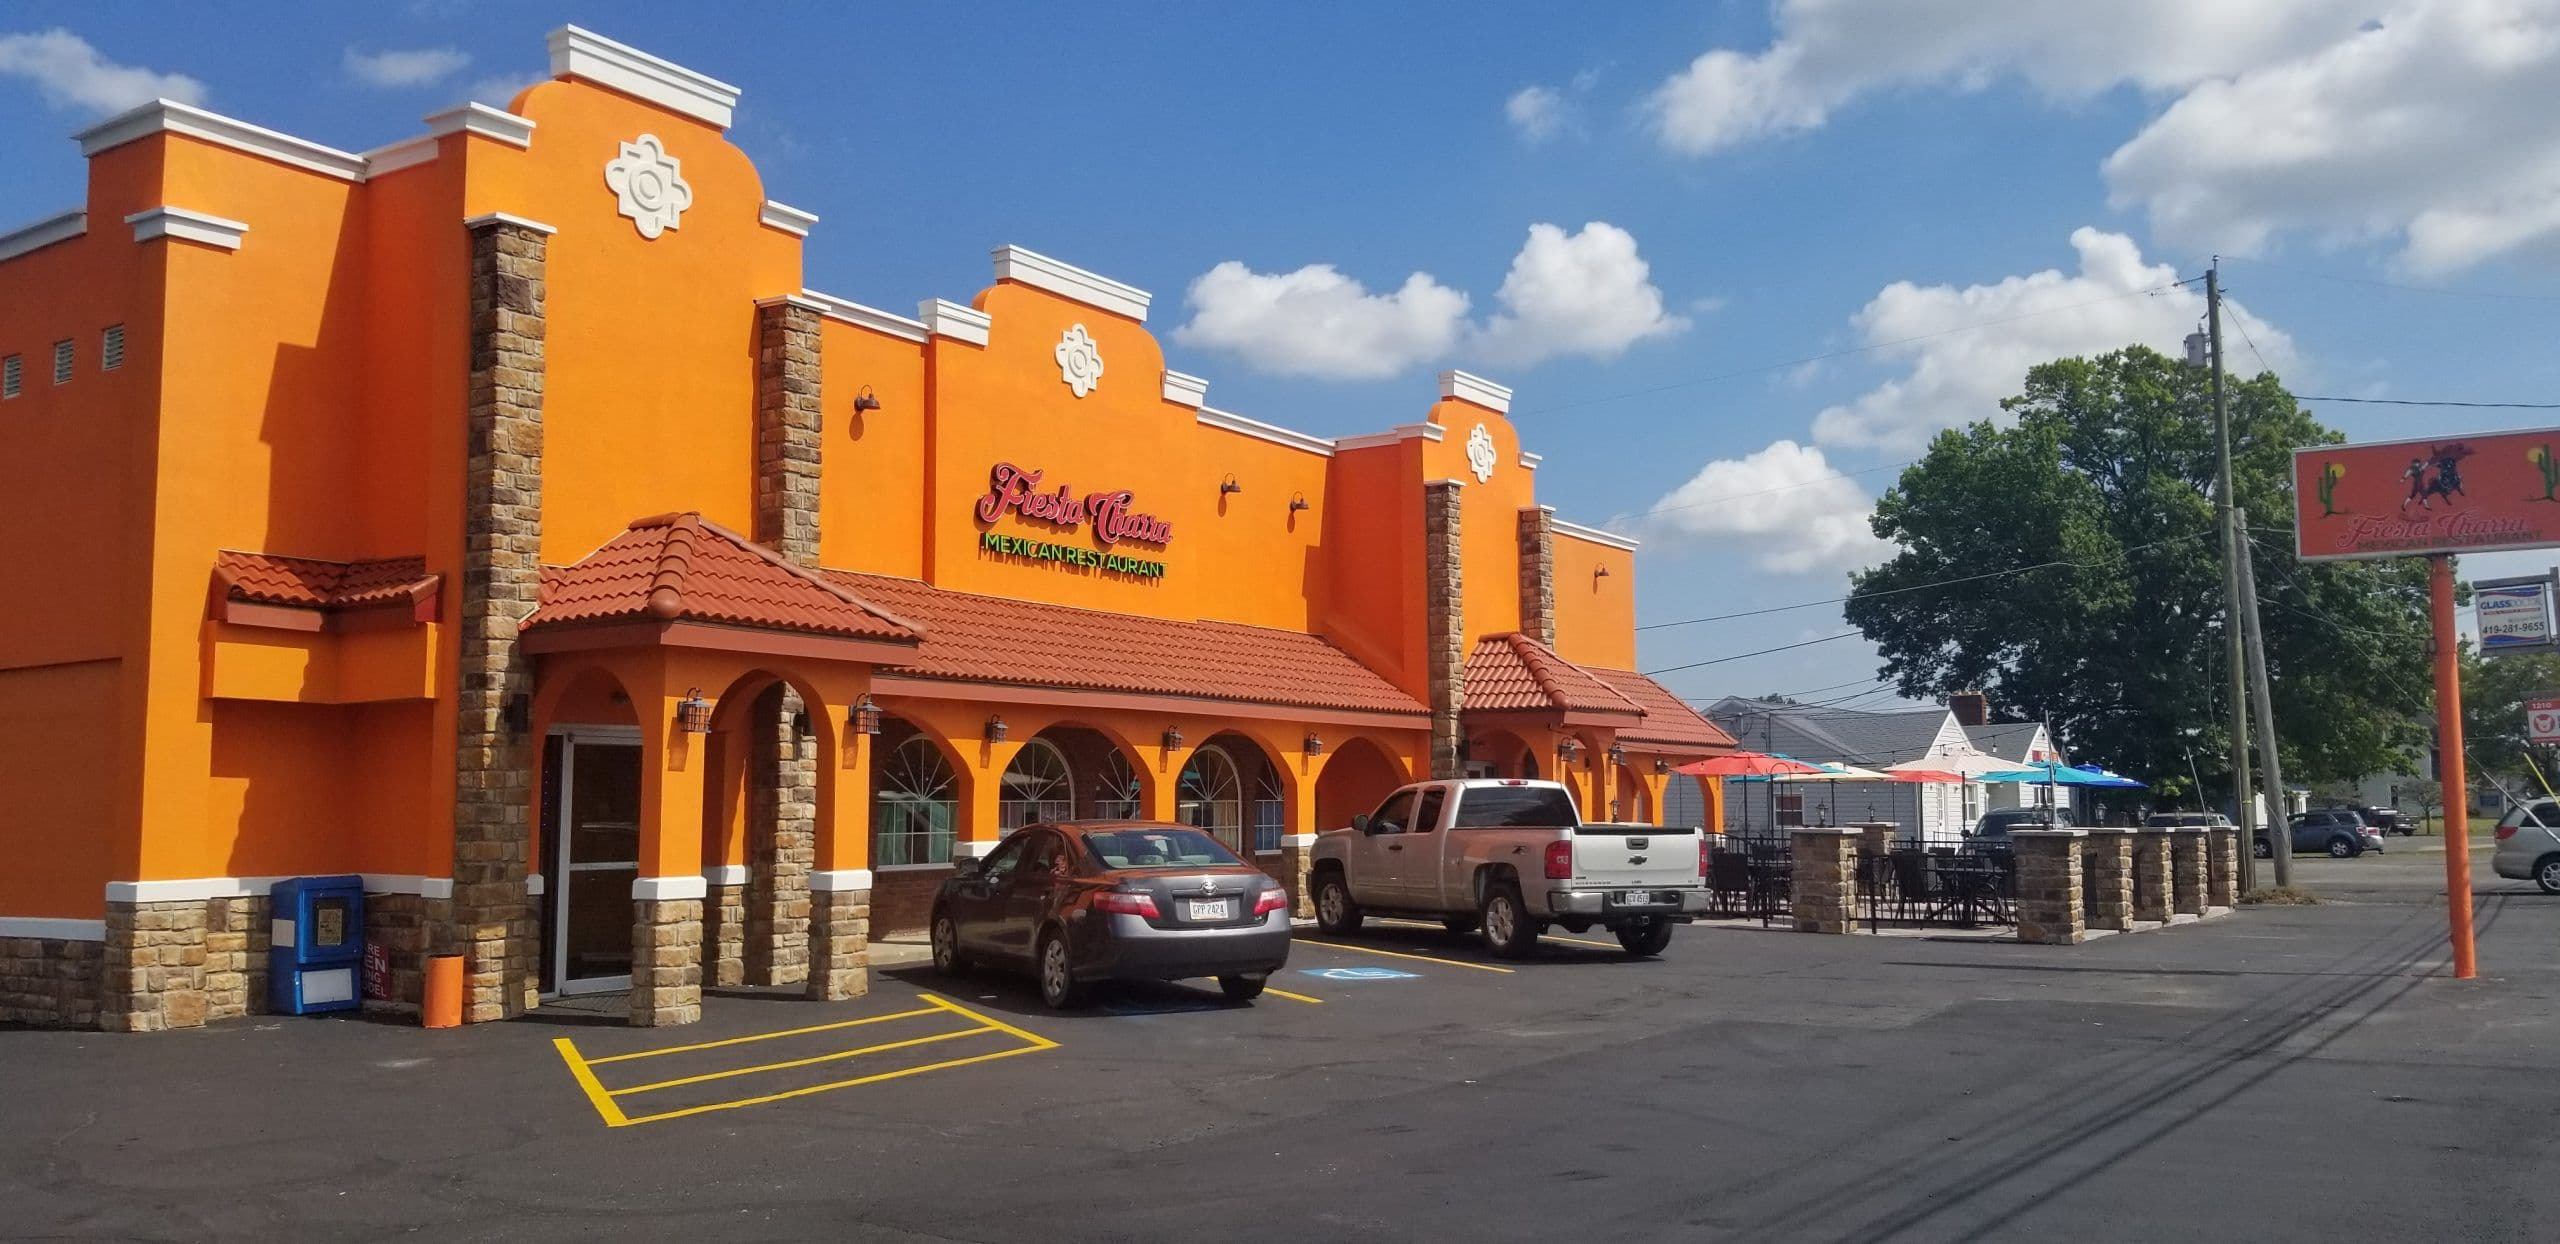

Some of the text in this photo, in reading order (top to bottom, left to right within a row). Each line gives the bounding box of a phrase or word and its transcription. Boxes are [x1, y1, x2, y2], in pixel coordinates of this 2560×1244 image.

[979, 461, 1173, 544] Fiesta Charra
[2336, 512, 2432, 549] Fiesta
[984, 532, 1168, 578] MEXICAN RESTAURANT
